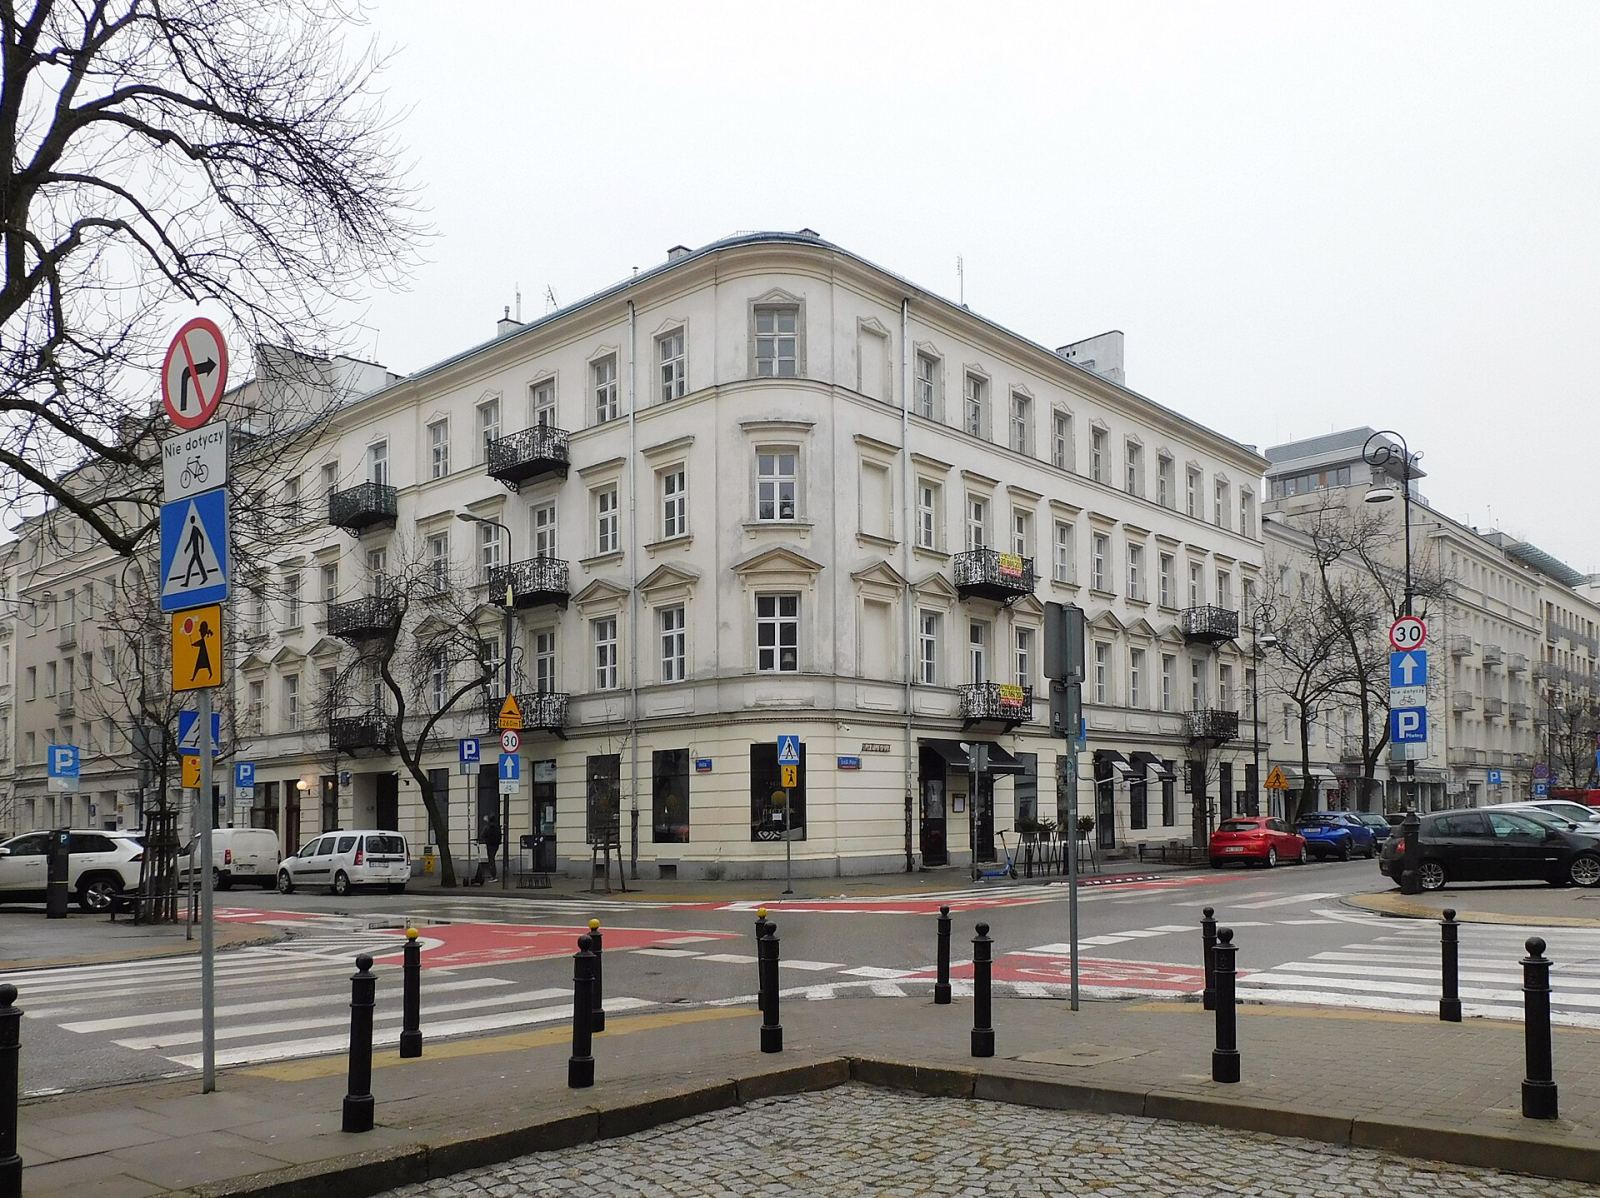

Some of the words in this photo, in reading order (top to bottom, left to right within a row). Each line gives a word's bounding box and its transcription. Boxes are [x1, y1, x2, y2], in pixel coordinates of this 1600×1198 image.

[165, 442, 182, 459] Nie
[185, 430, 224, 451] dotyczy
[1395, 626, 1421, 642] 30
[1398, 711, 1420, 739] P
[463, 740, 476, 760] P
[503, 735, 517, 748] 30
[55, 748, 73, 774] P
[239, 764, 252, 780] P
[60, 834, 67, 844] P
